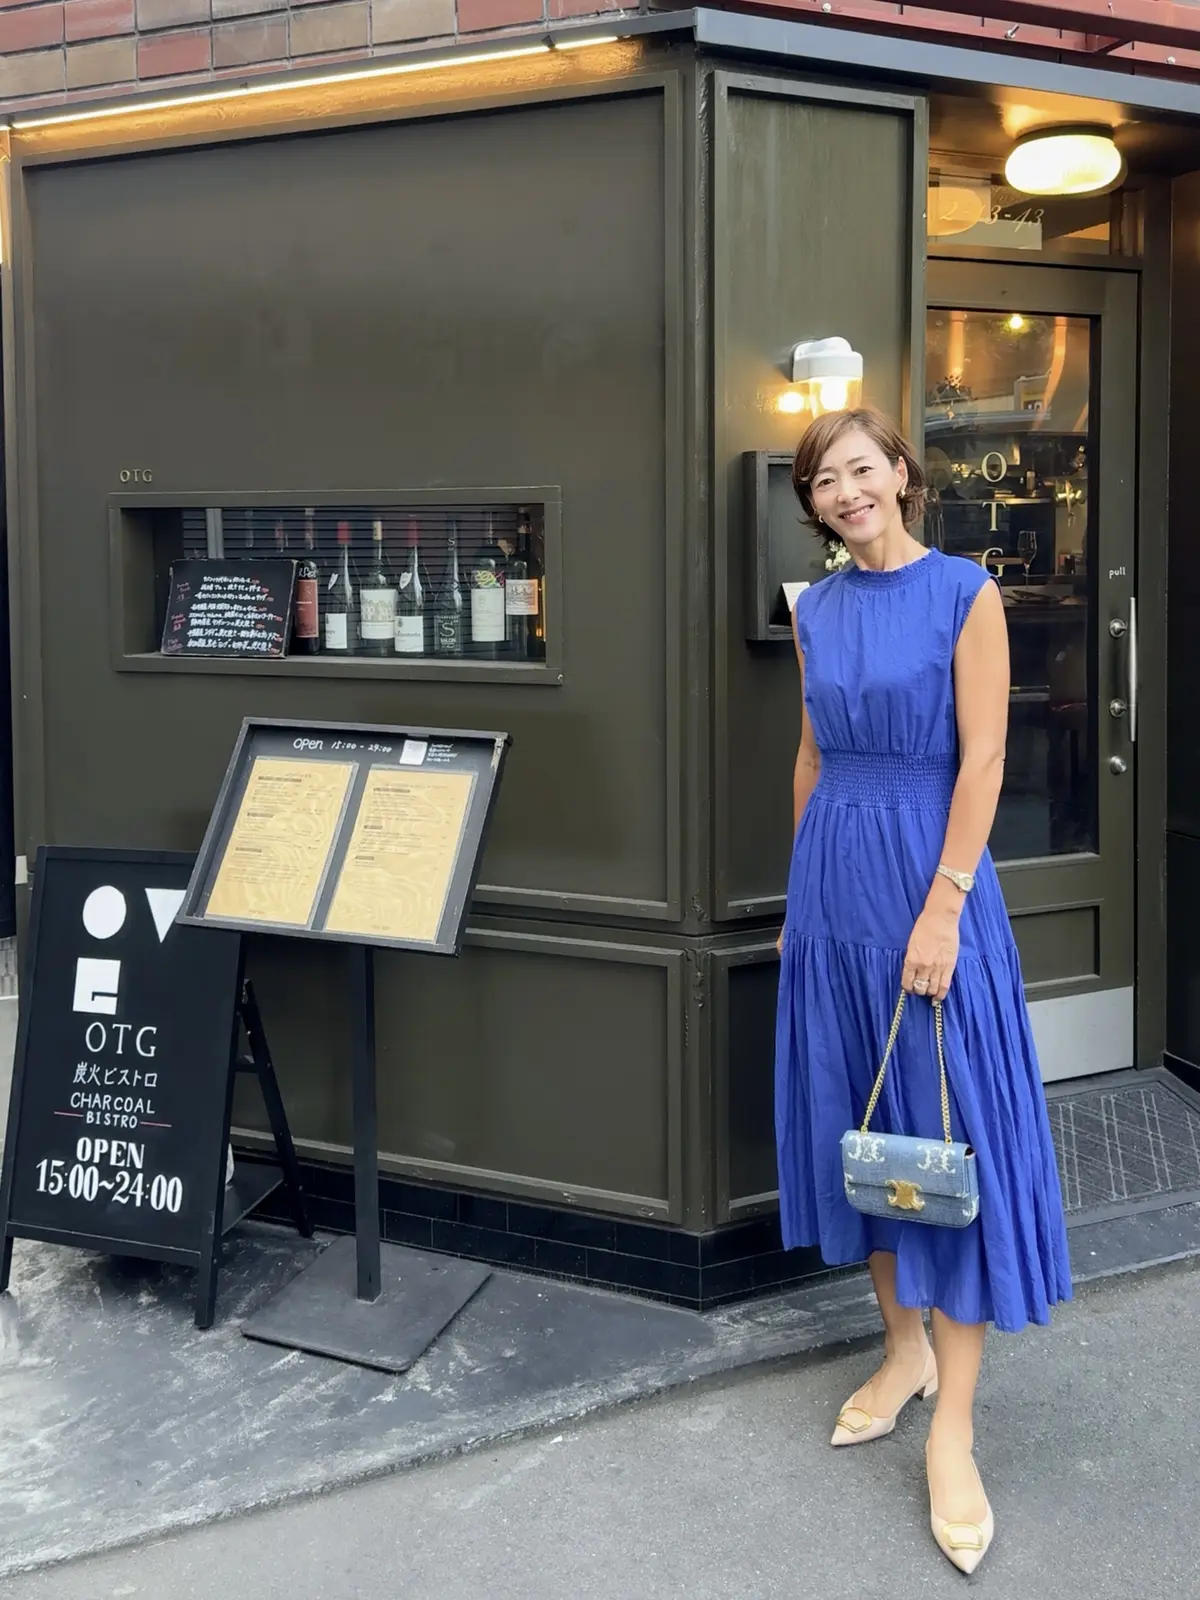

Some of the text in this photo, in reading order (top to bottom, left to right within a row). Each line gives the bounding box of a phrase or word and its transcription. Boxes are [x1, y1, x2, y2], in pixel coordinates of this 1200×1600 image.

[120, 468, 153, 483] OTG
[981, 451, 1007, 578] OTG
[1109, 566, 1126, 580] pull
[331, 740, 357, 750] 15:00
[367, 743, 392, 753] 24:00
[85, 1021, 157, 1057] OTG
[72, 1060, 158, 1087] 炭火ビストロ
[70, 1091, 155, 1114] CHARCOAL
[86, 1110, 138, 1129] BISTRO
[76, 1136, 145, 1169] OPEN
